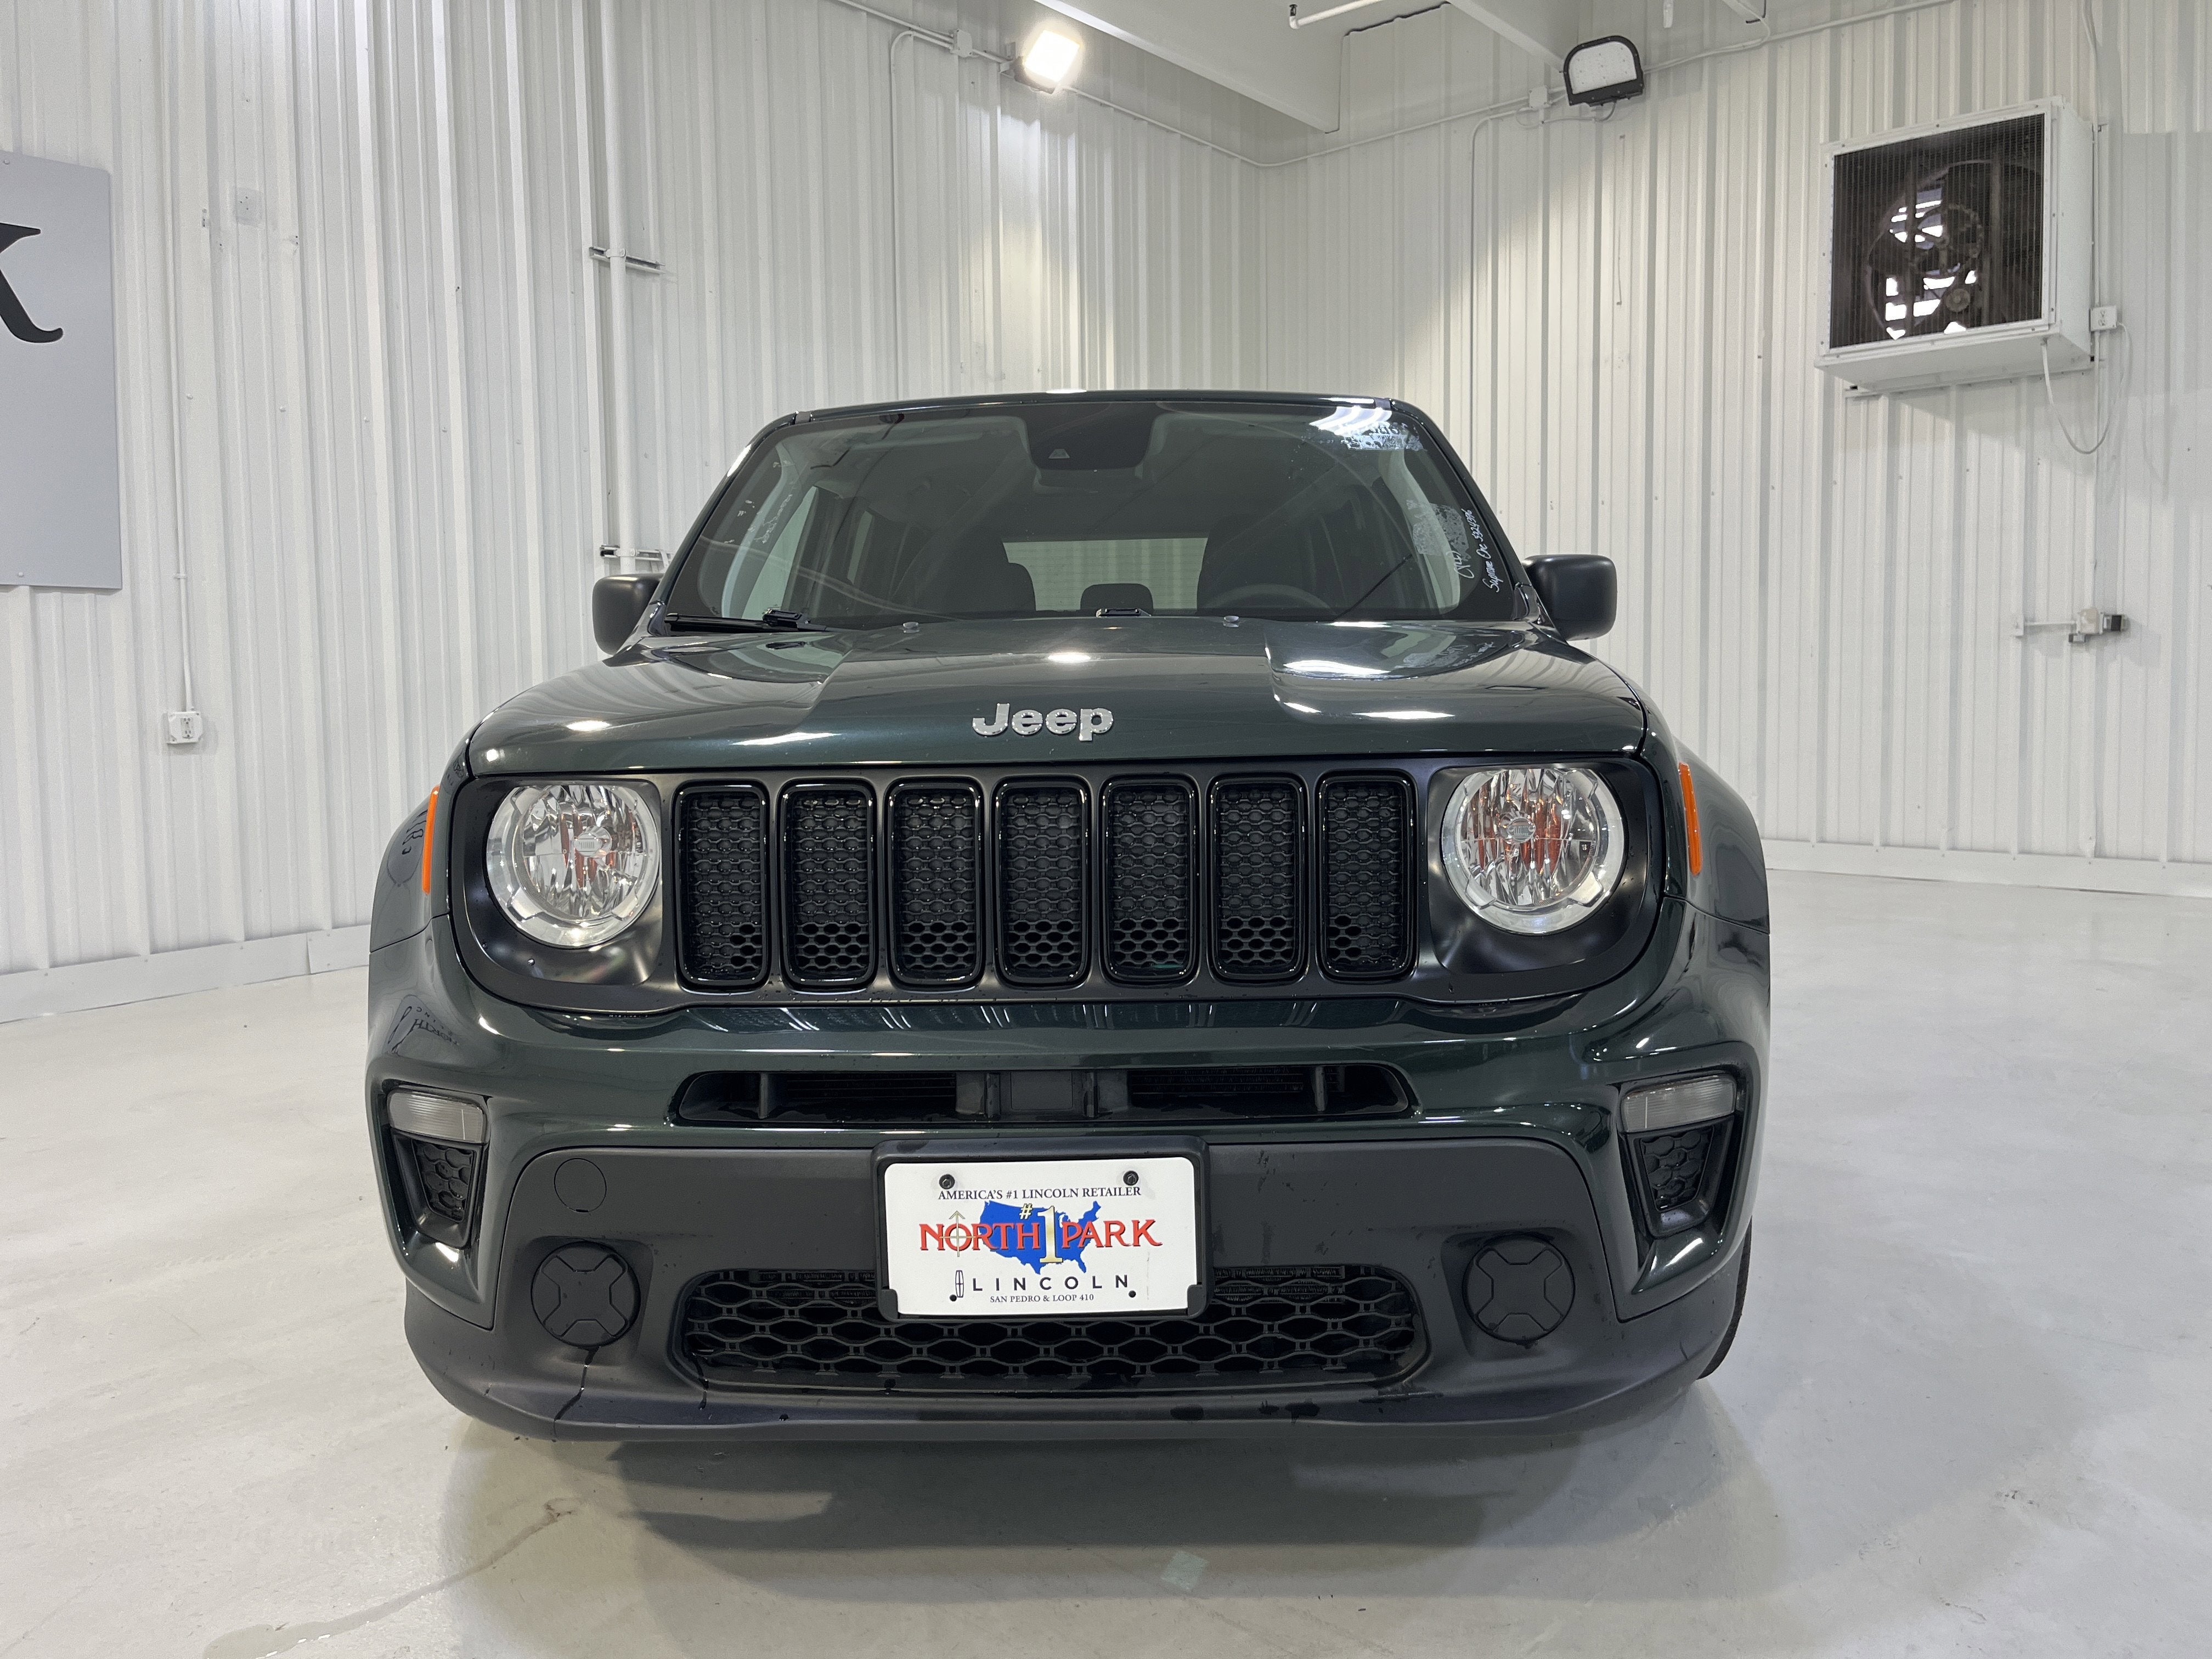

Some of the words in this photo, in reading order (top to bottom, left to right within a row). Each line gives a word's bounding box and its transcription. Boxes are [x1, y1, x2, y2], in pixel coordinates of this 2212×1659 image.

[972, 703, 1114, 741] Jeep
[938, 1189, 1003, 1200] AMERICA'S
[1006, 1190, 1018, 1199] #1
[1022, 1188, 1080, 1199] LINCOLN
[1082, 1187, 1142, 1198] RETAILER
[919, 1222, 1040, 1251] NORTH
[1062, 1219, 1163, 1249] PARK
[972, 1274, 1128, 1291] LINCOLN
[1079, 1293, 1094, 1301] 410
